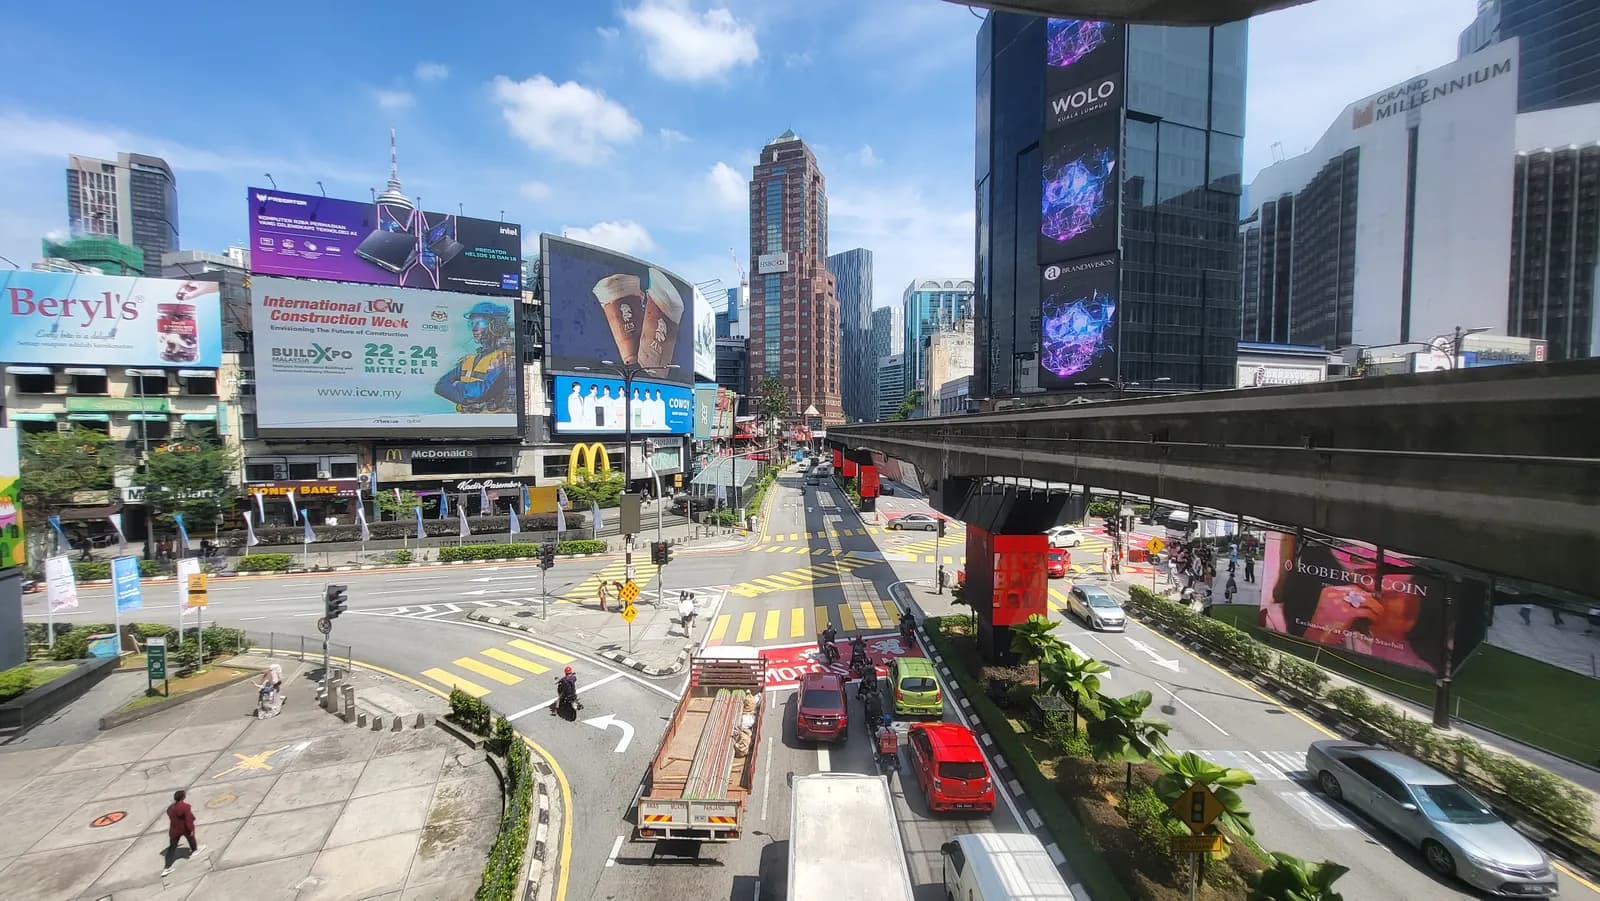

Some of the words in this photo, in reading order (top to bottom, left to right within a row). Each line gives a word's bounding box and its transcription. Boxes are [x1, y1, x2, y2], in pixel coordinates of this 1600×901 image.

[1376, 58, 1511, 121] MILLENNIUM
[1376, 79, 1429, 105] GRAND
[1052, 81, 1115, 115] WOLO
[1057, 111, 1078, 123] KUALA
[1080, 101, 1108, 115] LUMPUR
[499, 226, 518, 236] intel
[464, 251, 488, 259] HELIOS
[474, 247, 507, 256] PREDATOR
[7, 287, 139, 327] Beryl's
[263, 295, 362, 313] International
[270, 309, 367, 327] Construction
[371, 315, 409, 329] Week
[270, 324, 315, 334] Envisioning
[365, 329, 409, 338] Construction
[364, 342, 394, 358] 22
[410, 345, 438, 360] 24
[364, 357, 438, 368] OCTOBER
[364, 366, 407, 375] MITEC,
[410, 367, 425, 375] KL
[317, 386, 402, 400] www.icw.my
[411, 448, 473, 458] McDonald's
[300, 485, 337, 495] BAKE
[1297, 562, 1375, 587] ROBERTO
[1380, 579, 1428, 597] COIN
